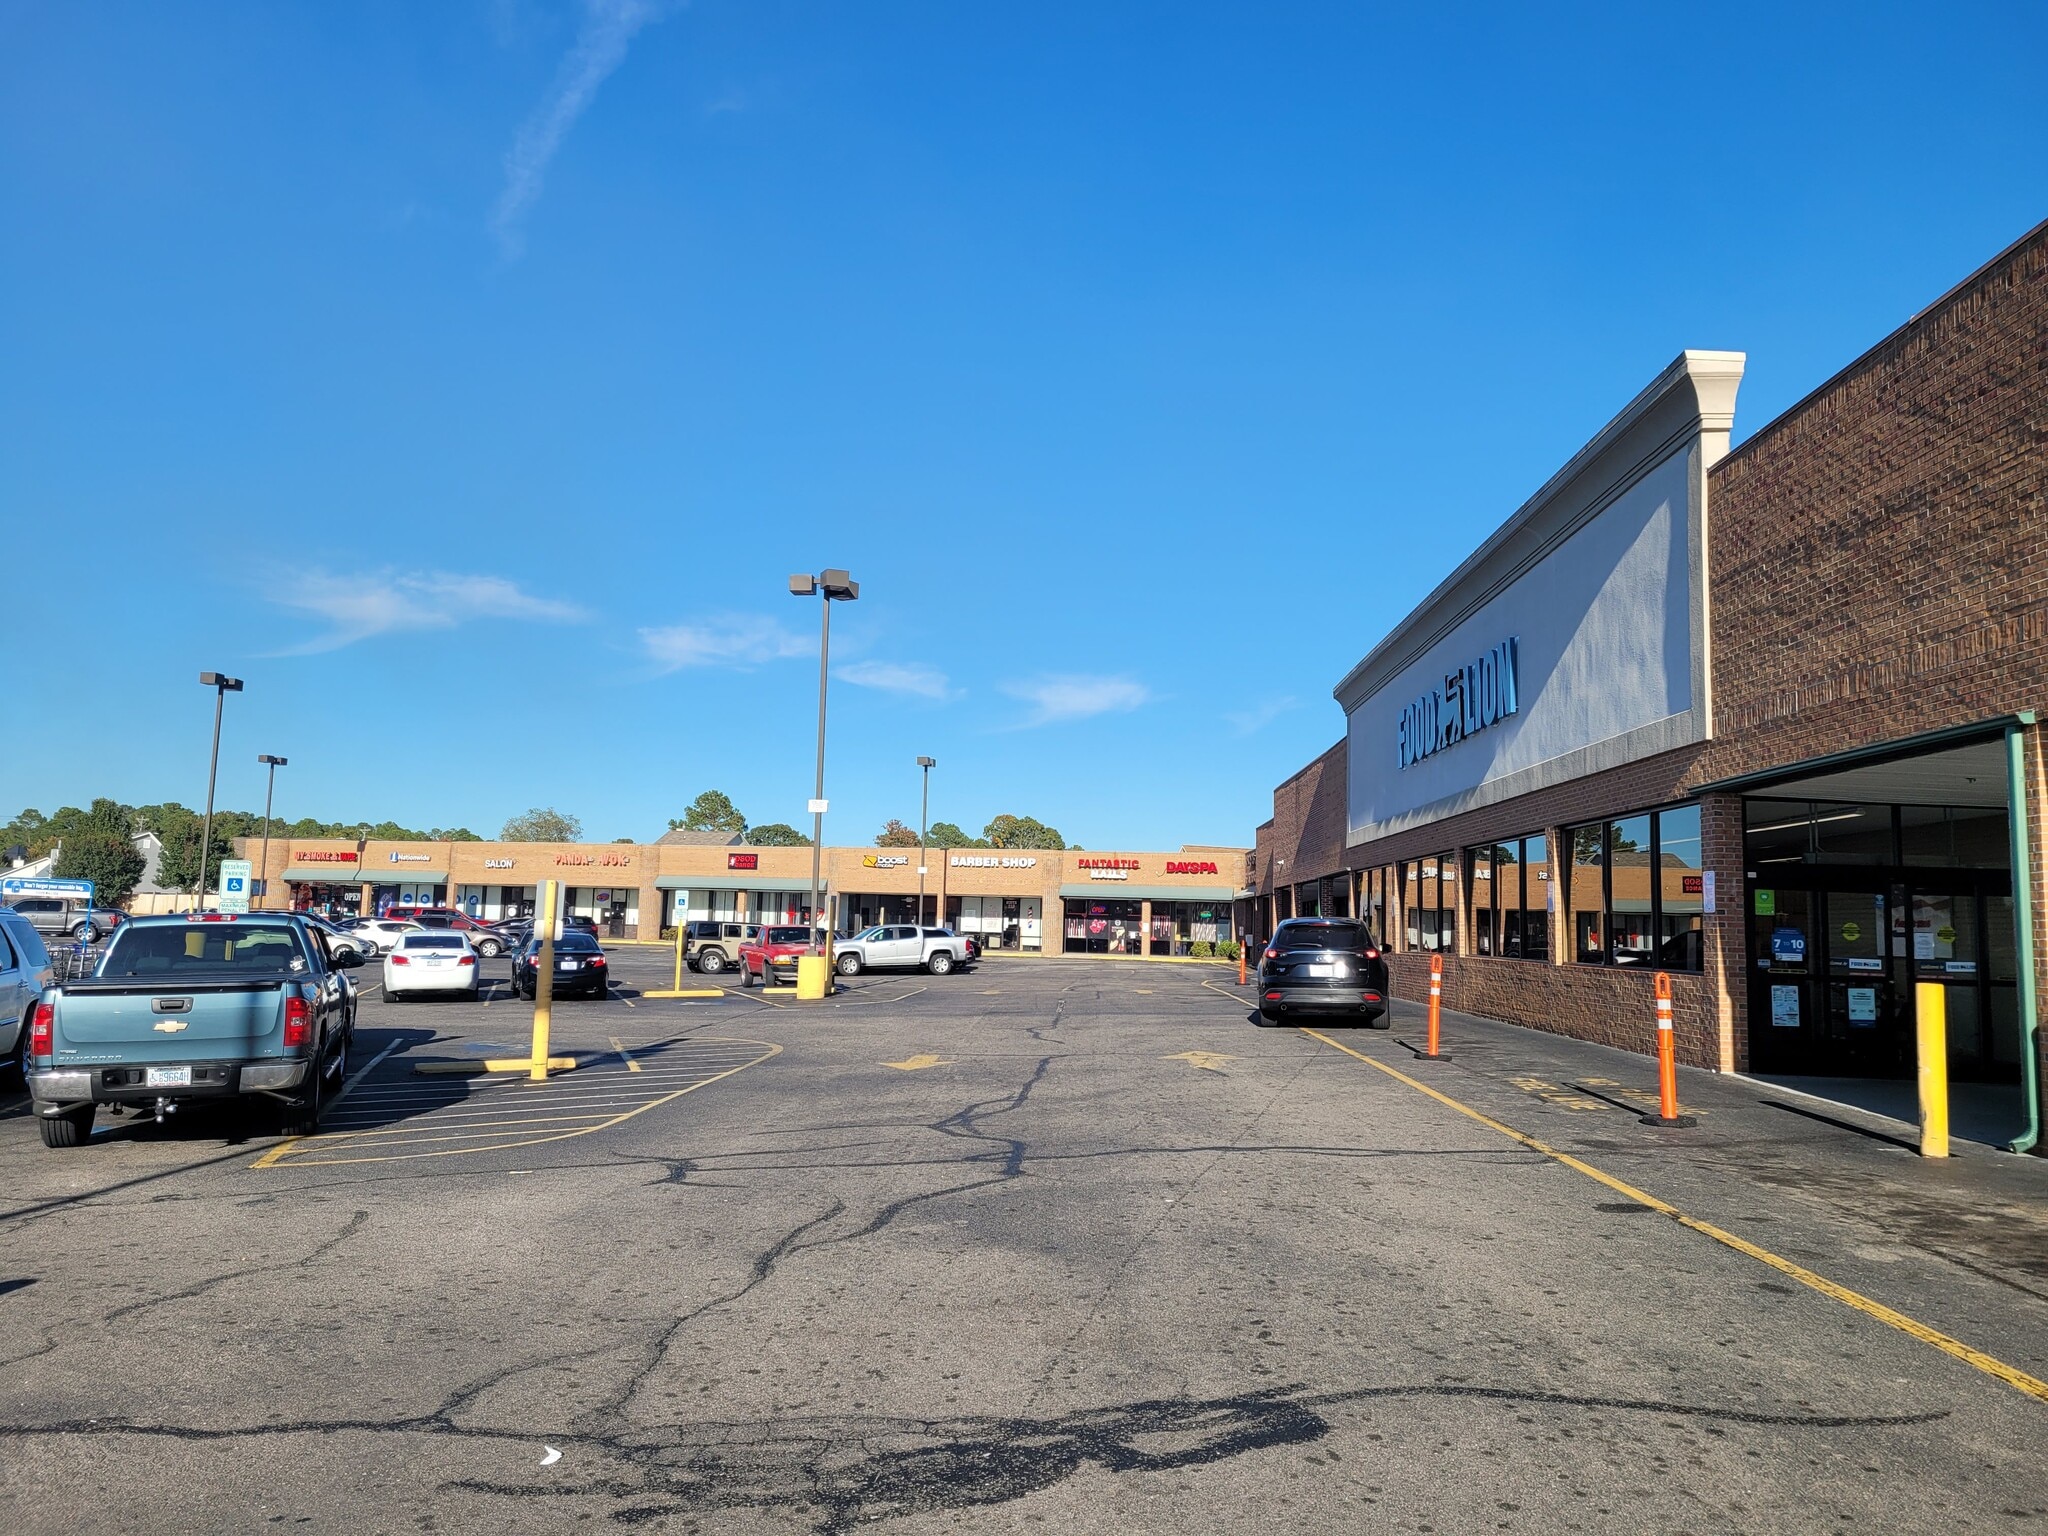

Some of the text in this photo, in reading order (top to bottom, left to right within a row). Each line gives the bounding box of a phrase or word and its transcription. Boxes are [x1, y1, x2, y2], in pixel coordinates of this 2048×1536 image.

[1398, 636, 1519, 769] FOOD LION
[304, 852, 330, 860] SMOKE
[555, 853, 628, 866] PANDA WOK
[877, 854, 908, 864] boost
[485, 859, 513, 868] SALON
[951, 856, 1036, 868] BARBER SHOP
[1079, 859, 1140, 869] FANTASTIC
[1090, 870, 1128, 879] NAILS
[344, 892, 361, 901] OPEN
[1773, 939, 1781, 948] 7
[1791, 940, 1804, 949] 10
